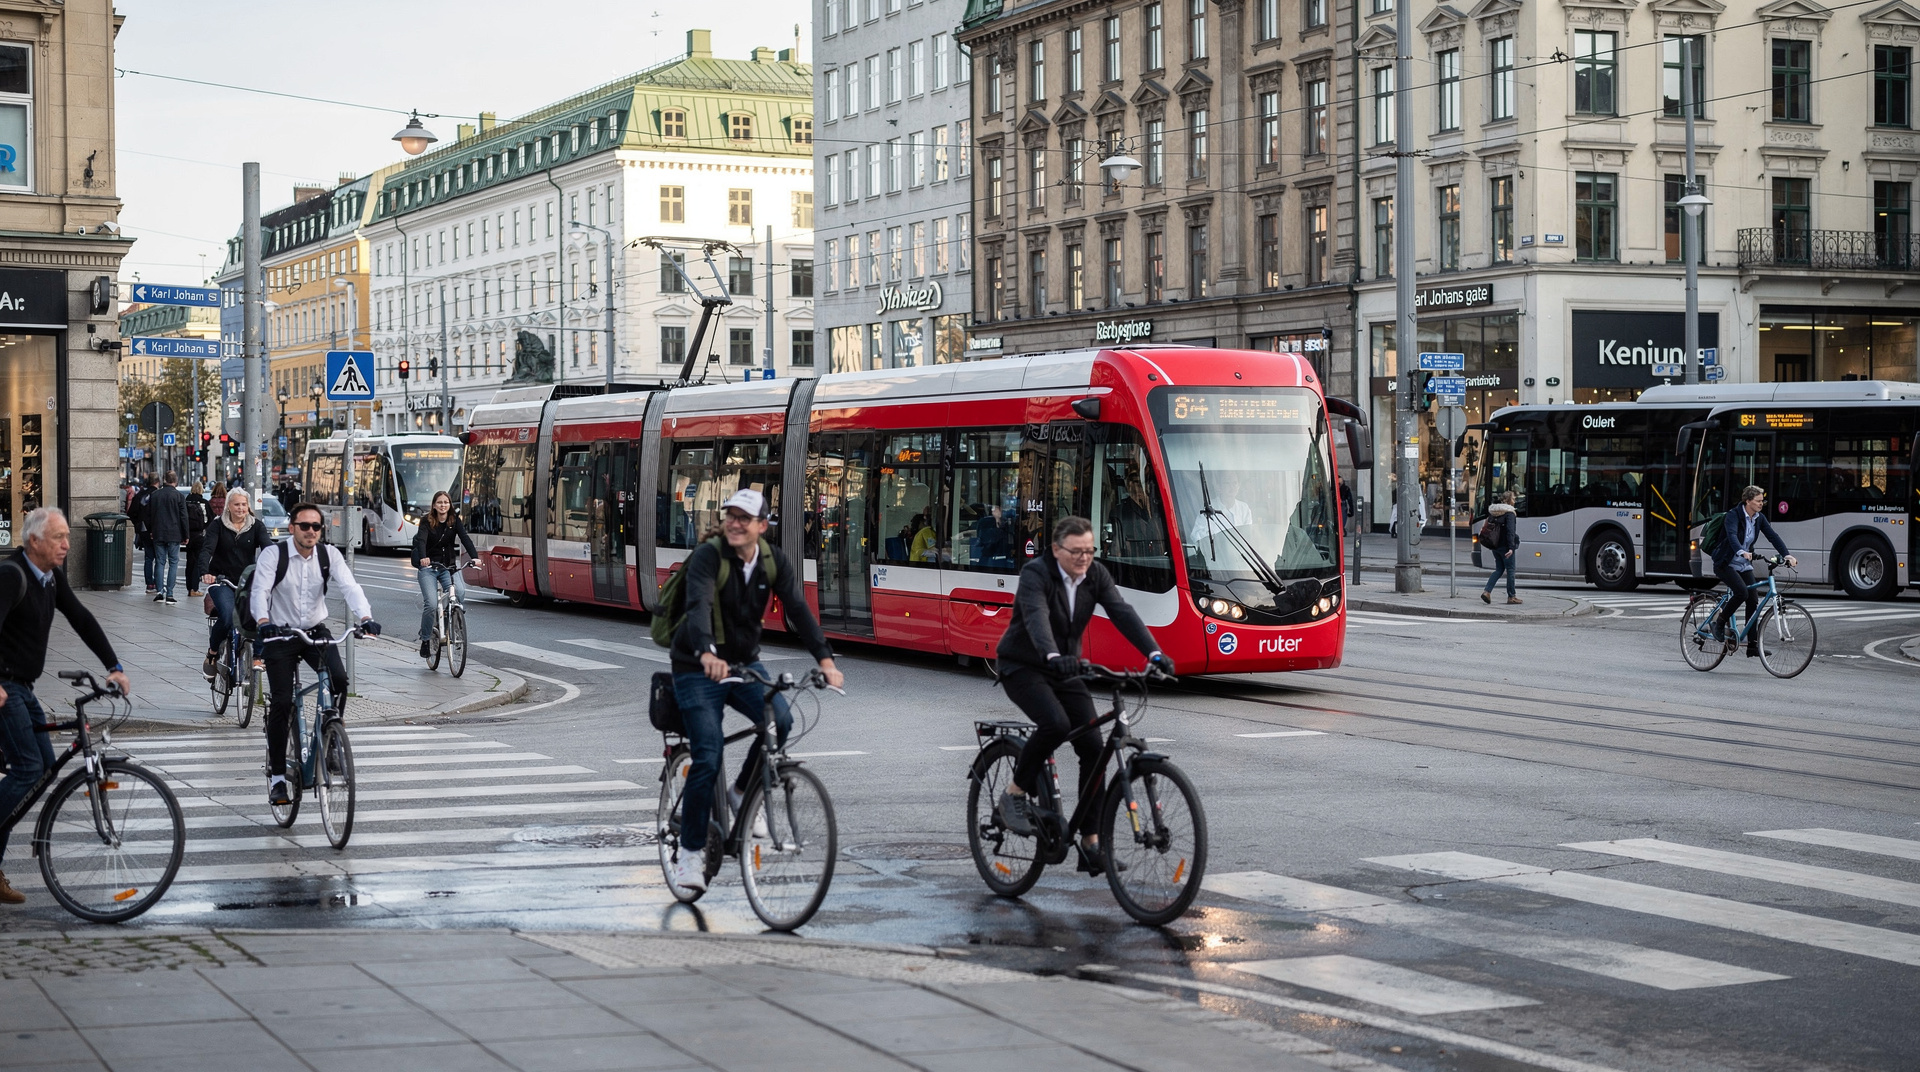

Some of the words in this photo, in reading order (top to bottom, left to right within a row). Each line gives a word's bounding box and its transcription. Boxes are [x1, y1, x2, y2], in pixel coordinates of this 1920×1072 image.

[151, 287, 171, 299] Karl
[1414, 290, 1427, 307] arl
[1429, 288, 1464, 306] Johans
[1466, 286, 1488, 306] gate
[151, 341, 171, 352] Karl
[1259, 635, 1303, 653] ruter
